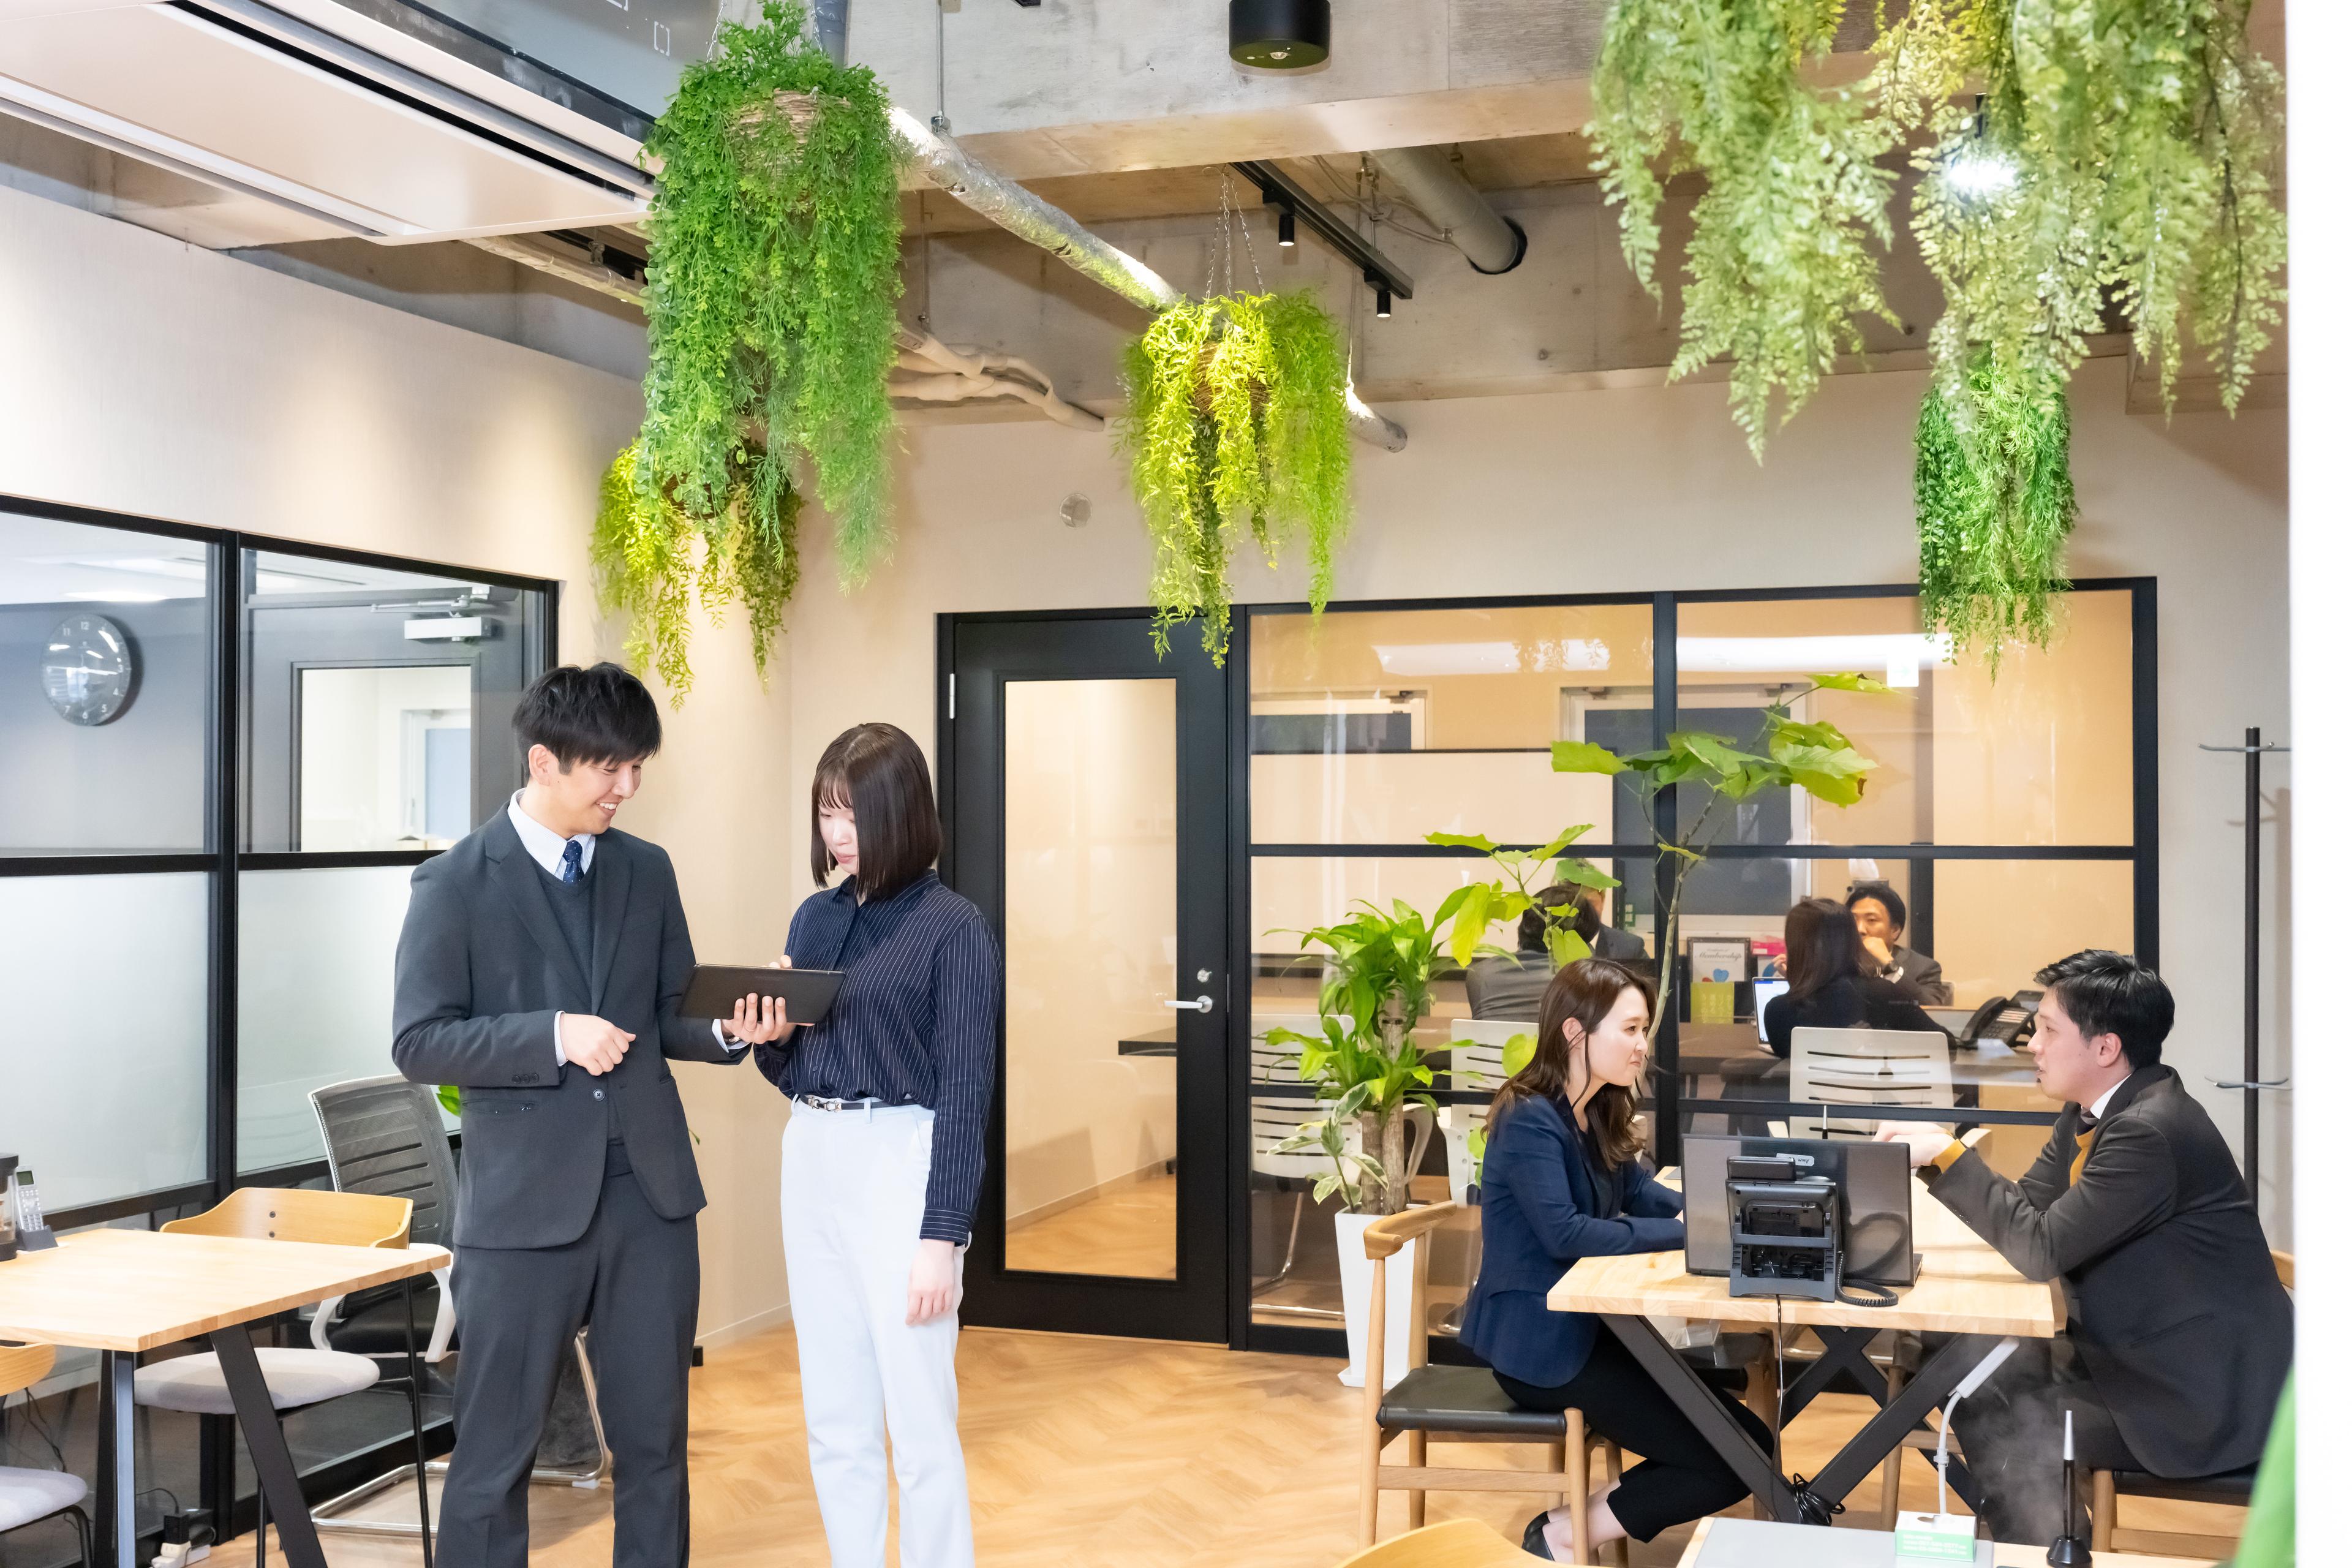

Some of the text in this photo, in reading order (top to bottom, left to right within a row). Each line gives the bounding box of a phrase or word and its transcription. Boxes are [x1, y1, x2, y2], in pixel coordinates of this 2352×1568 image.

[81, 622, 89, 630] 12
[118, 665, 123, 673] 3
[113, 687, 119, 696] 4
[64, 705, 71, 714] 7
[101, 704, 107, 712] 5
[1698, 951, 1742, 961] Membership
